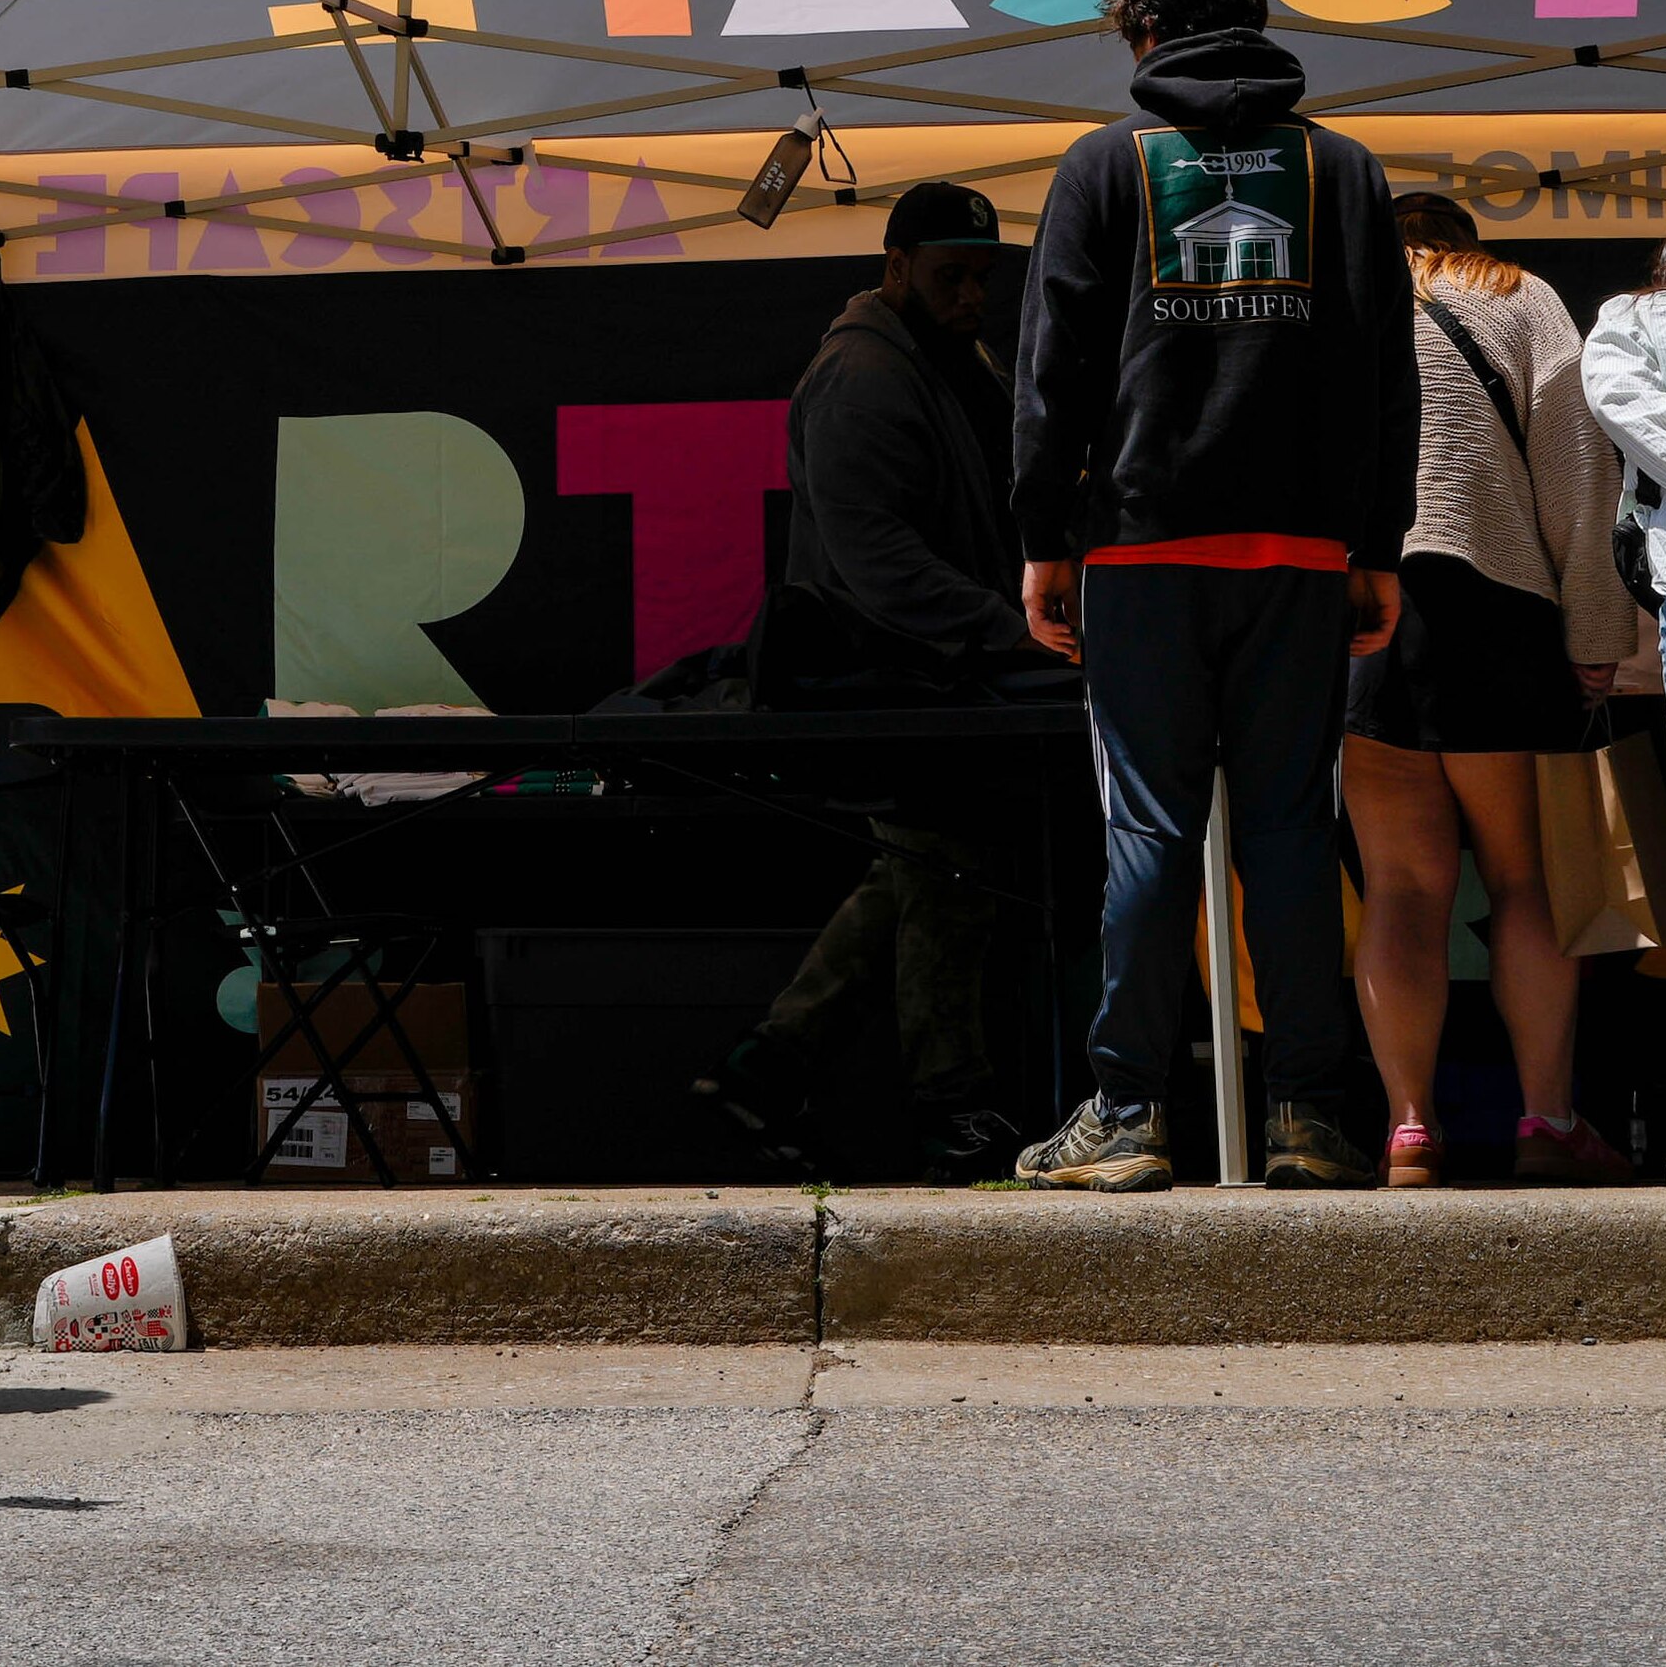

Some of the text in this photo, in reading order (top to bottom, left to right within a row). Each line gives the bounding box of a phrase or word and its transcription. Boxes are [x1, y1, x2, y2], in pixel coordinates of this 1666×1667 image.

[759, 160, 782, 192] SCAPE
[1225, 151, 1267, 173] 1990
[772, 171, 787, 192] ART
[1153, 293, 1312, 322] SOUTHFEN
[122, 1259, 136, 1295] Checkers
